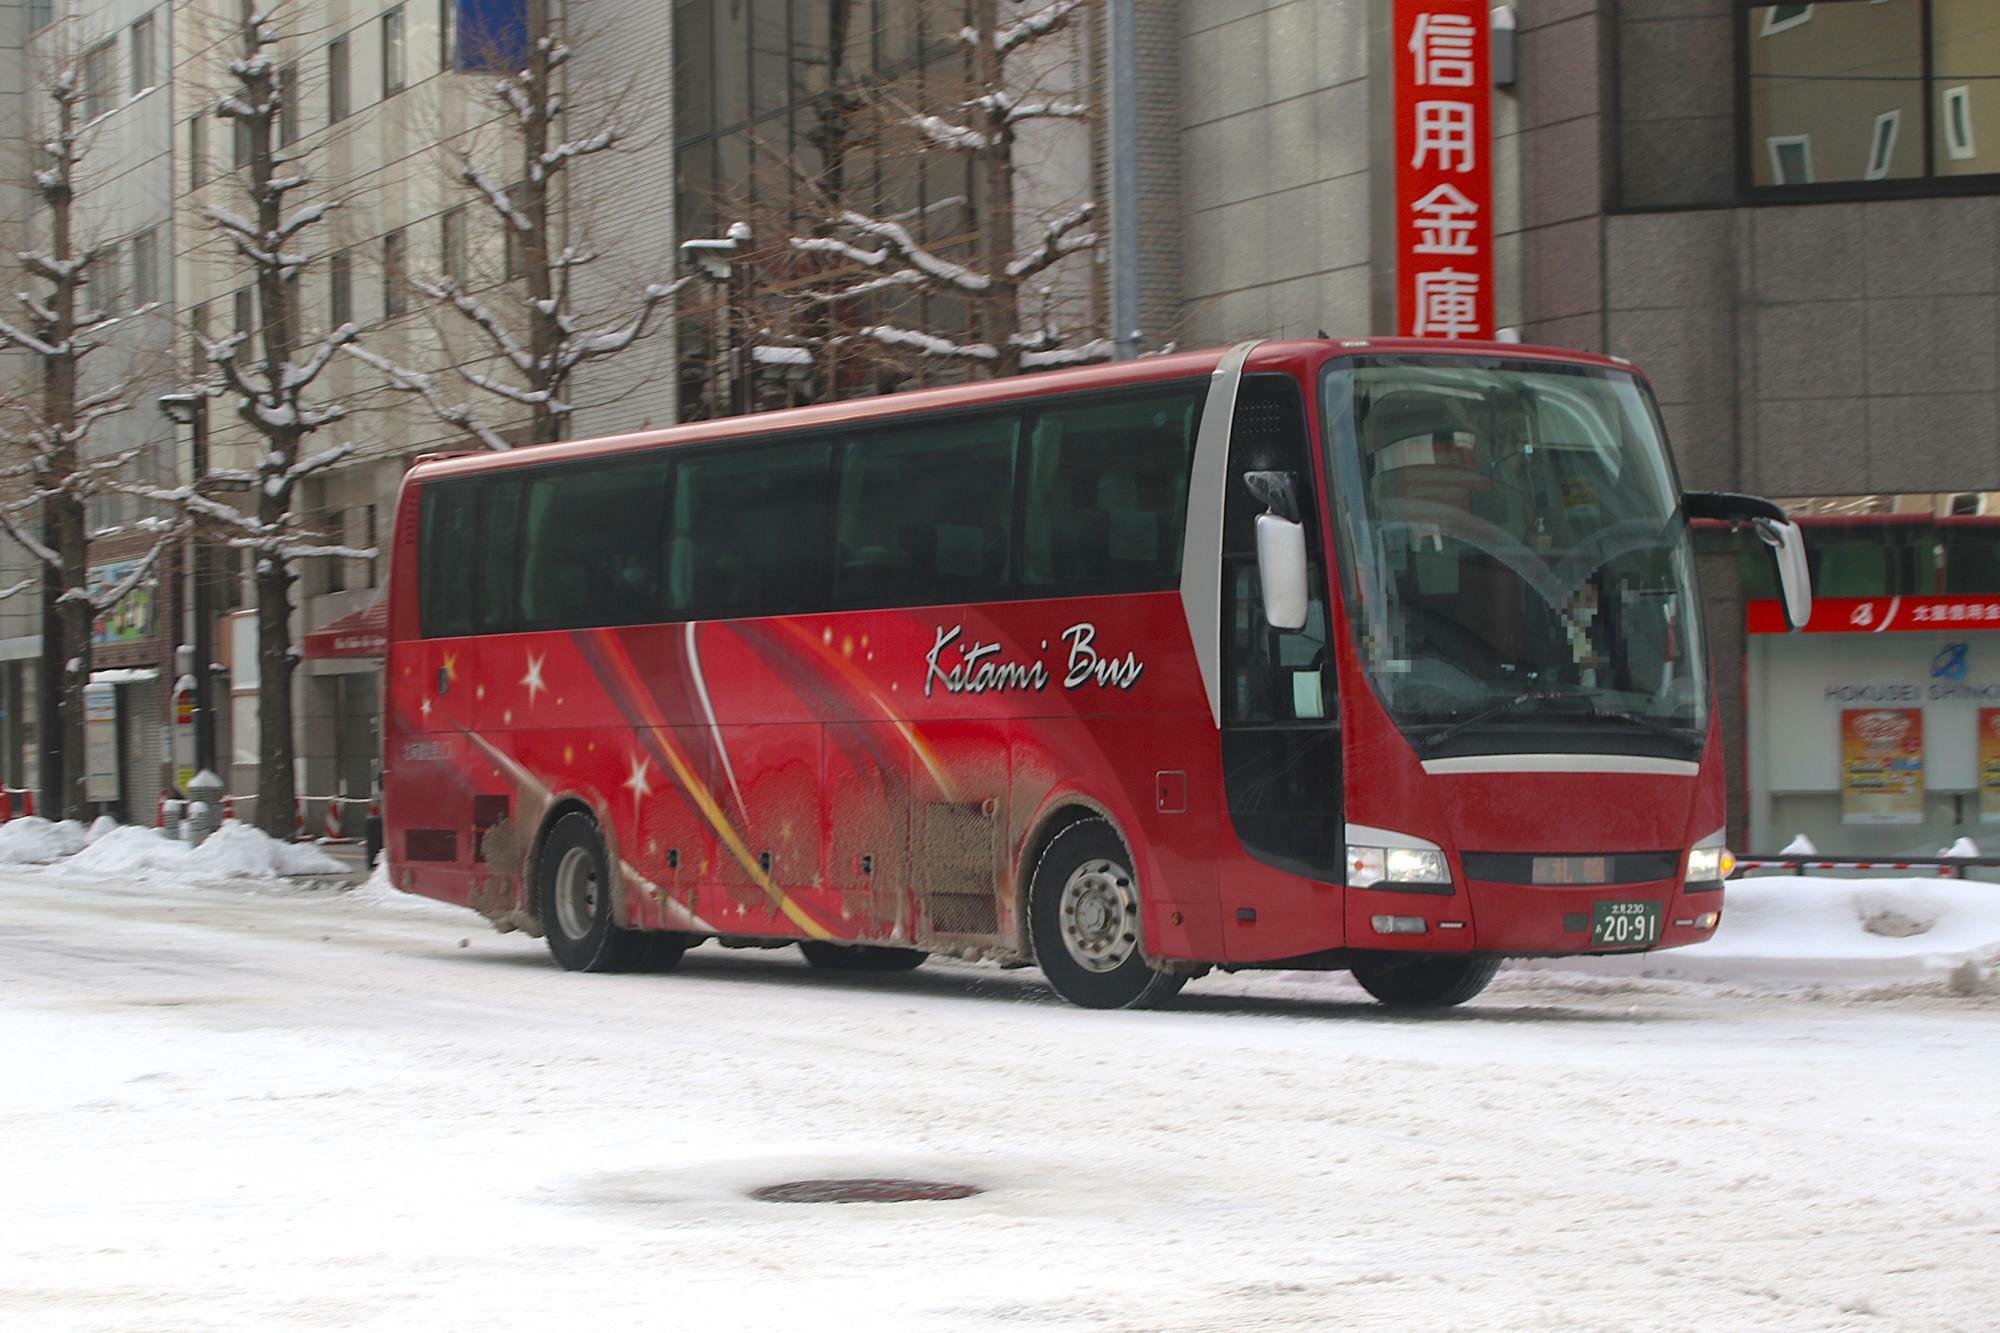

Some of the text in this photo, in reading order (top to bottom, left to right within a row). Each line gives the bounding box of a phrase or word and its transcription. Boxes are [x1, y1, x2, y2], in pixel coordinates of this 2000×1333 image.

[1408, 13, 1480, 340] 信用金庫
[925, 623, 1143, 697] Kitami Bus
